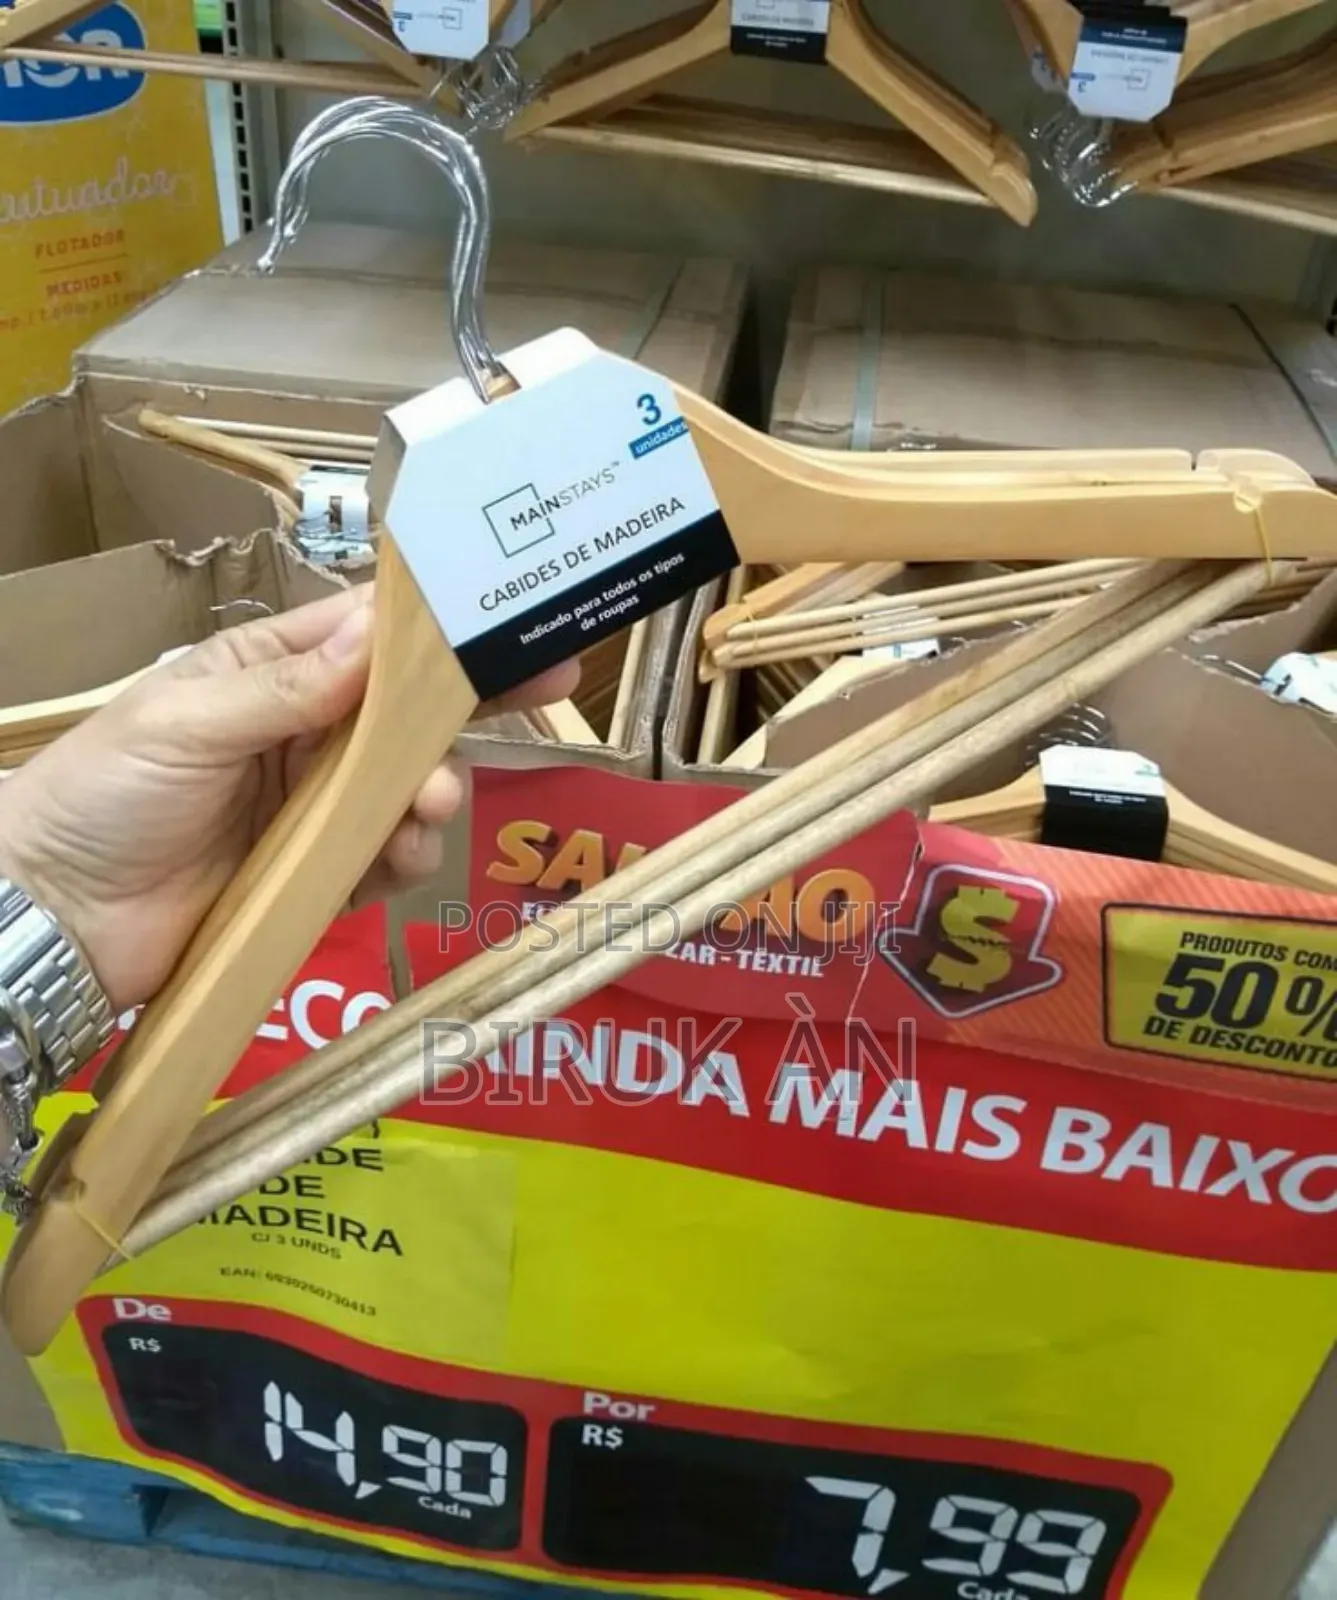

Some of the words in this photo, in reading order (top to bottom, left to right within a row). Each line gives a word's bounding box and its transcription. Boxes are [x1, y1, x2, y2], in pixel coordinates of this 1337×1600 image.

[34, 229, 125, 259] FLOTADOR
[637, 393, 662, 425] 3
[479, 559, 562, 611] CABIDES
[563, 544, 592, 568] DE
[594, 496, 686, 553] MADEIRA
[520, 611, 572, 644] Indicado
[573, 597, 602, 619] para
[602, 577, 637, 601] todos
[638, 570, 653, 583] os
[654, 553, 685, 576] tipos
[580, 616, 597, 632] de
[598, 594, 640, 622] roupas
[659, 941, 716, 966] ZAR
[1179, 931, 1289, 962] PRODUTOS
[1143, 1016, 1184, 1040] DE
[1189, 1025, 1337, 1068] DESCONTO
[484, 1019, 751, 1118] INDA
[769, 1060, 1028, 1161] MAIS
[1040, 1106, 1337, 1214] BAIXO
[259, 1174, 326, 1199] DE
[276, 1234, 287, 1245] 3
[291, 1235, 342, 1260] UNDS
[220, 1266, 261, 1279] EAN:
[113, 1297, 172, 1322] De
[129, 1336, 162, 1354] R$
[583, 1391, 655, 1421] Por
[263, 1380, 508, 1507] 14,90
[582, 1424, 625, 1450] R$
[418, 1495, 472, 1519] Cada
[805, 1475, 1107, 1595] 7,99
